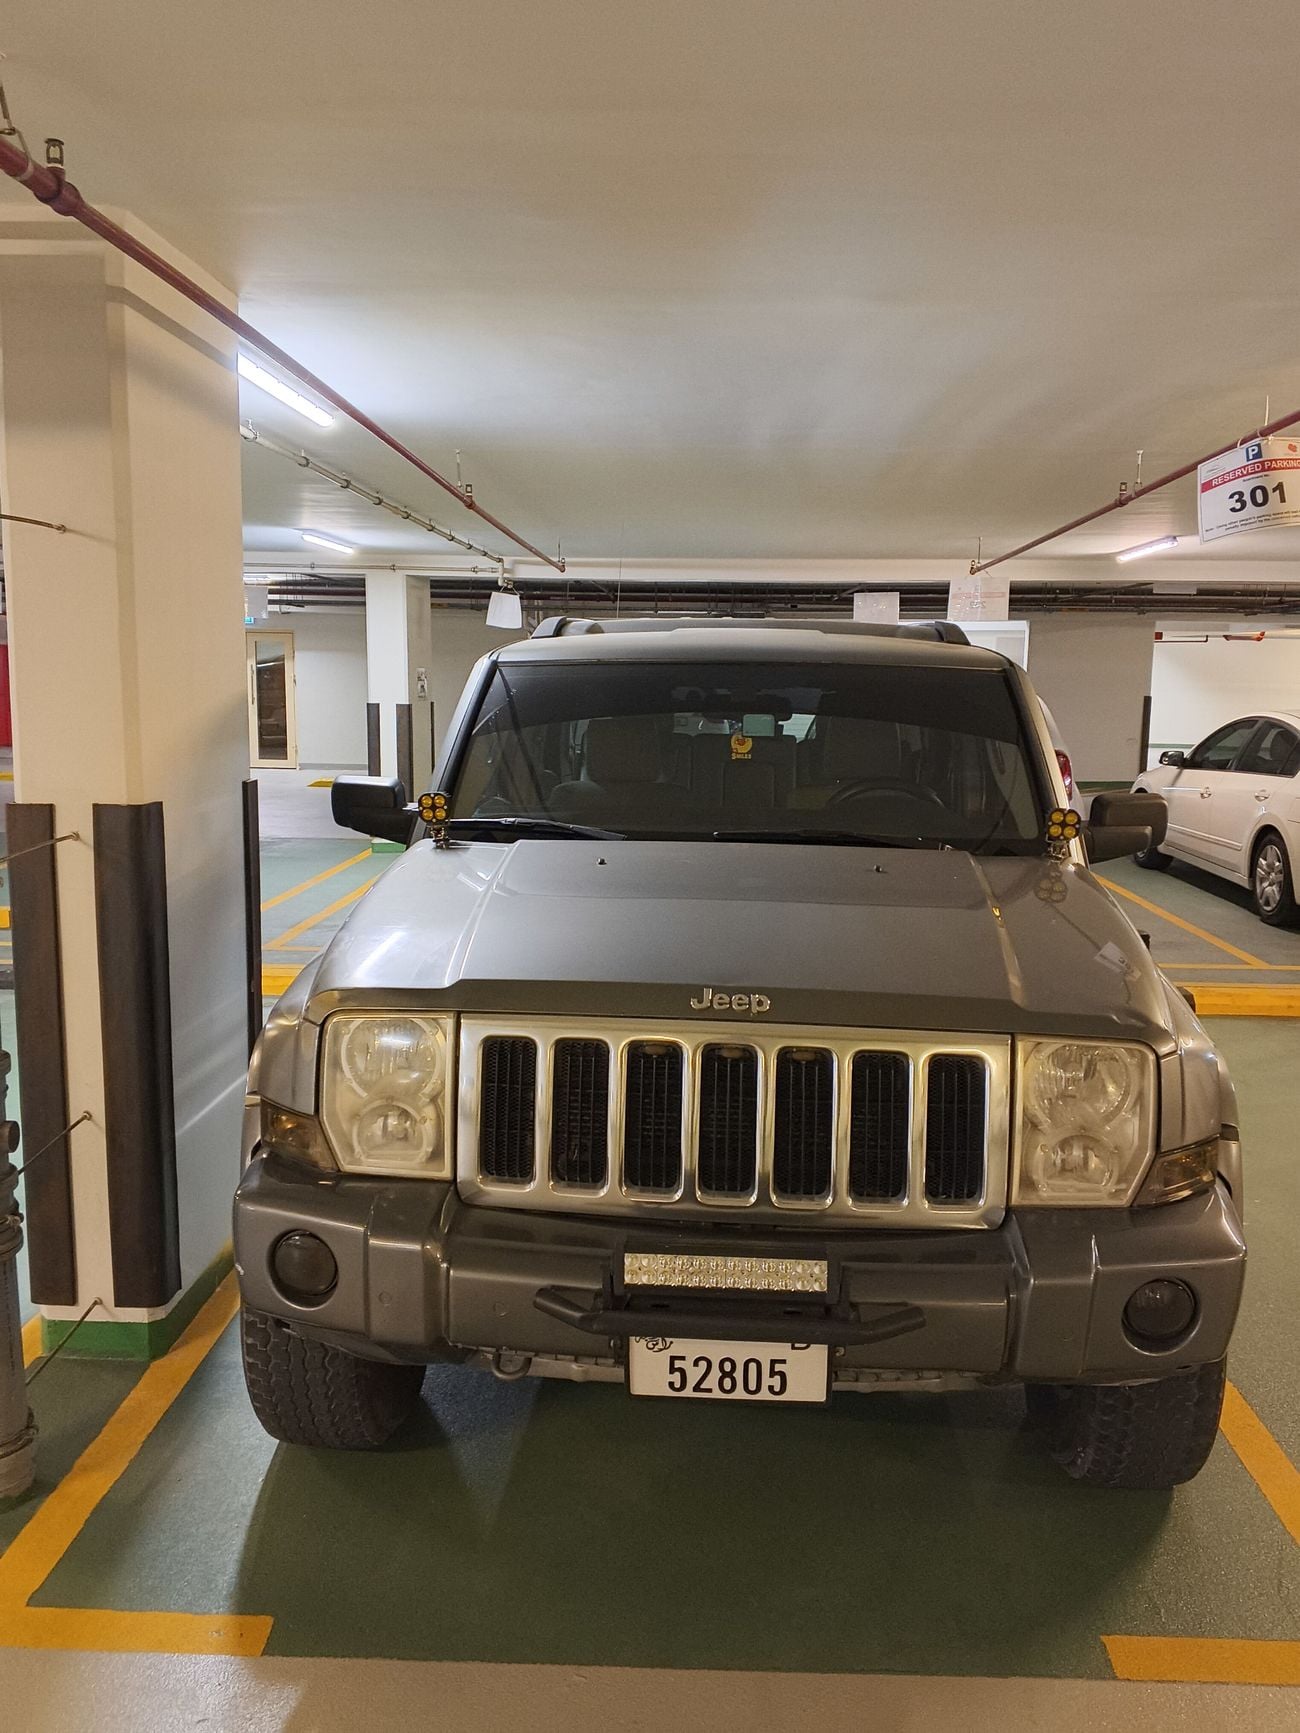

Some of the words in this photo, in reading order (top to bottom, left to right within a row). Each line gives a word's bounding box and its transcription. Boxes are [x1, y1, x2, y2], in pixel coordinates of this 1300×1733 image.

[1247, 445, 1259, 459] P
[1212, 463, 1262, 487] RESERVED
[1228, 481, 1286, 513] 301
[690, 987, 771, 1016] Jeep
[667, 1355, 788, 1396] 52805
